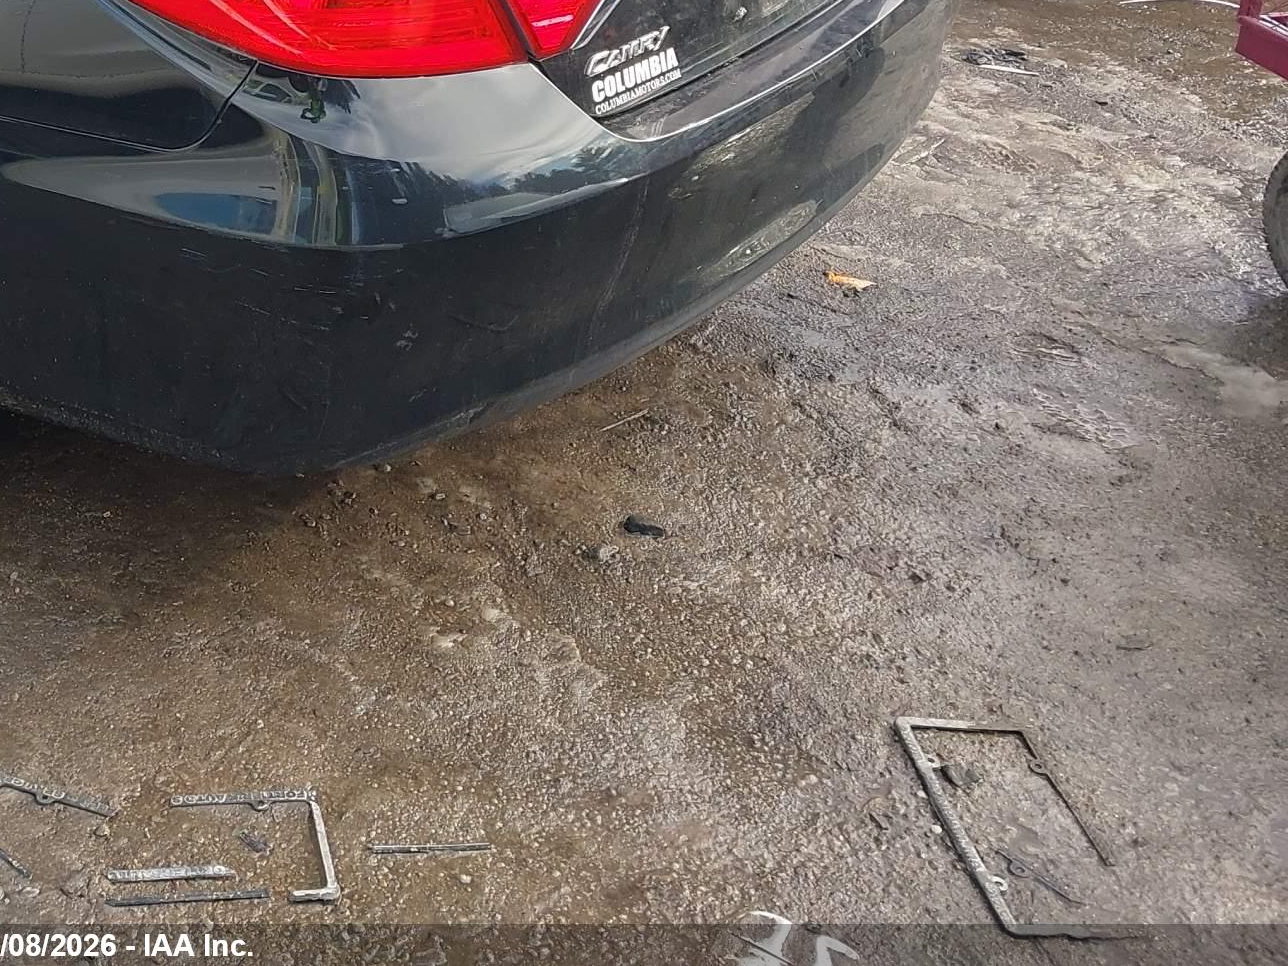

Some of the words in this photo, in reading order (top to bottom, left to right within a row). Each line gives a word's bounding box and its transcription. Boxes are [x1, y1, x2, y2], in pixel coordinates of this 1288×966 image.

[585, 25, 670, 77] CAMRY
[592, 47, 679, 103] COLUMBIA
[595, 68, 682, 115] COLUMBIAMOTORS.COM
